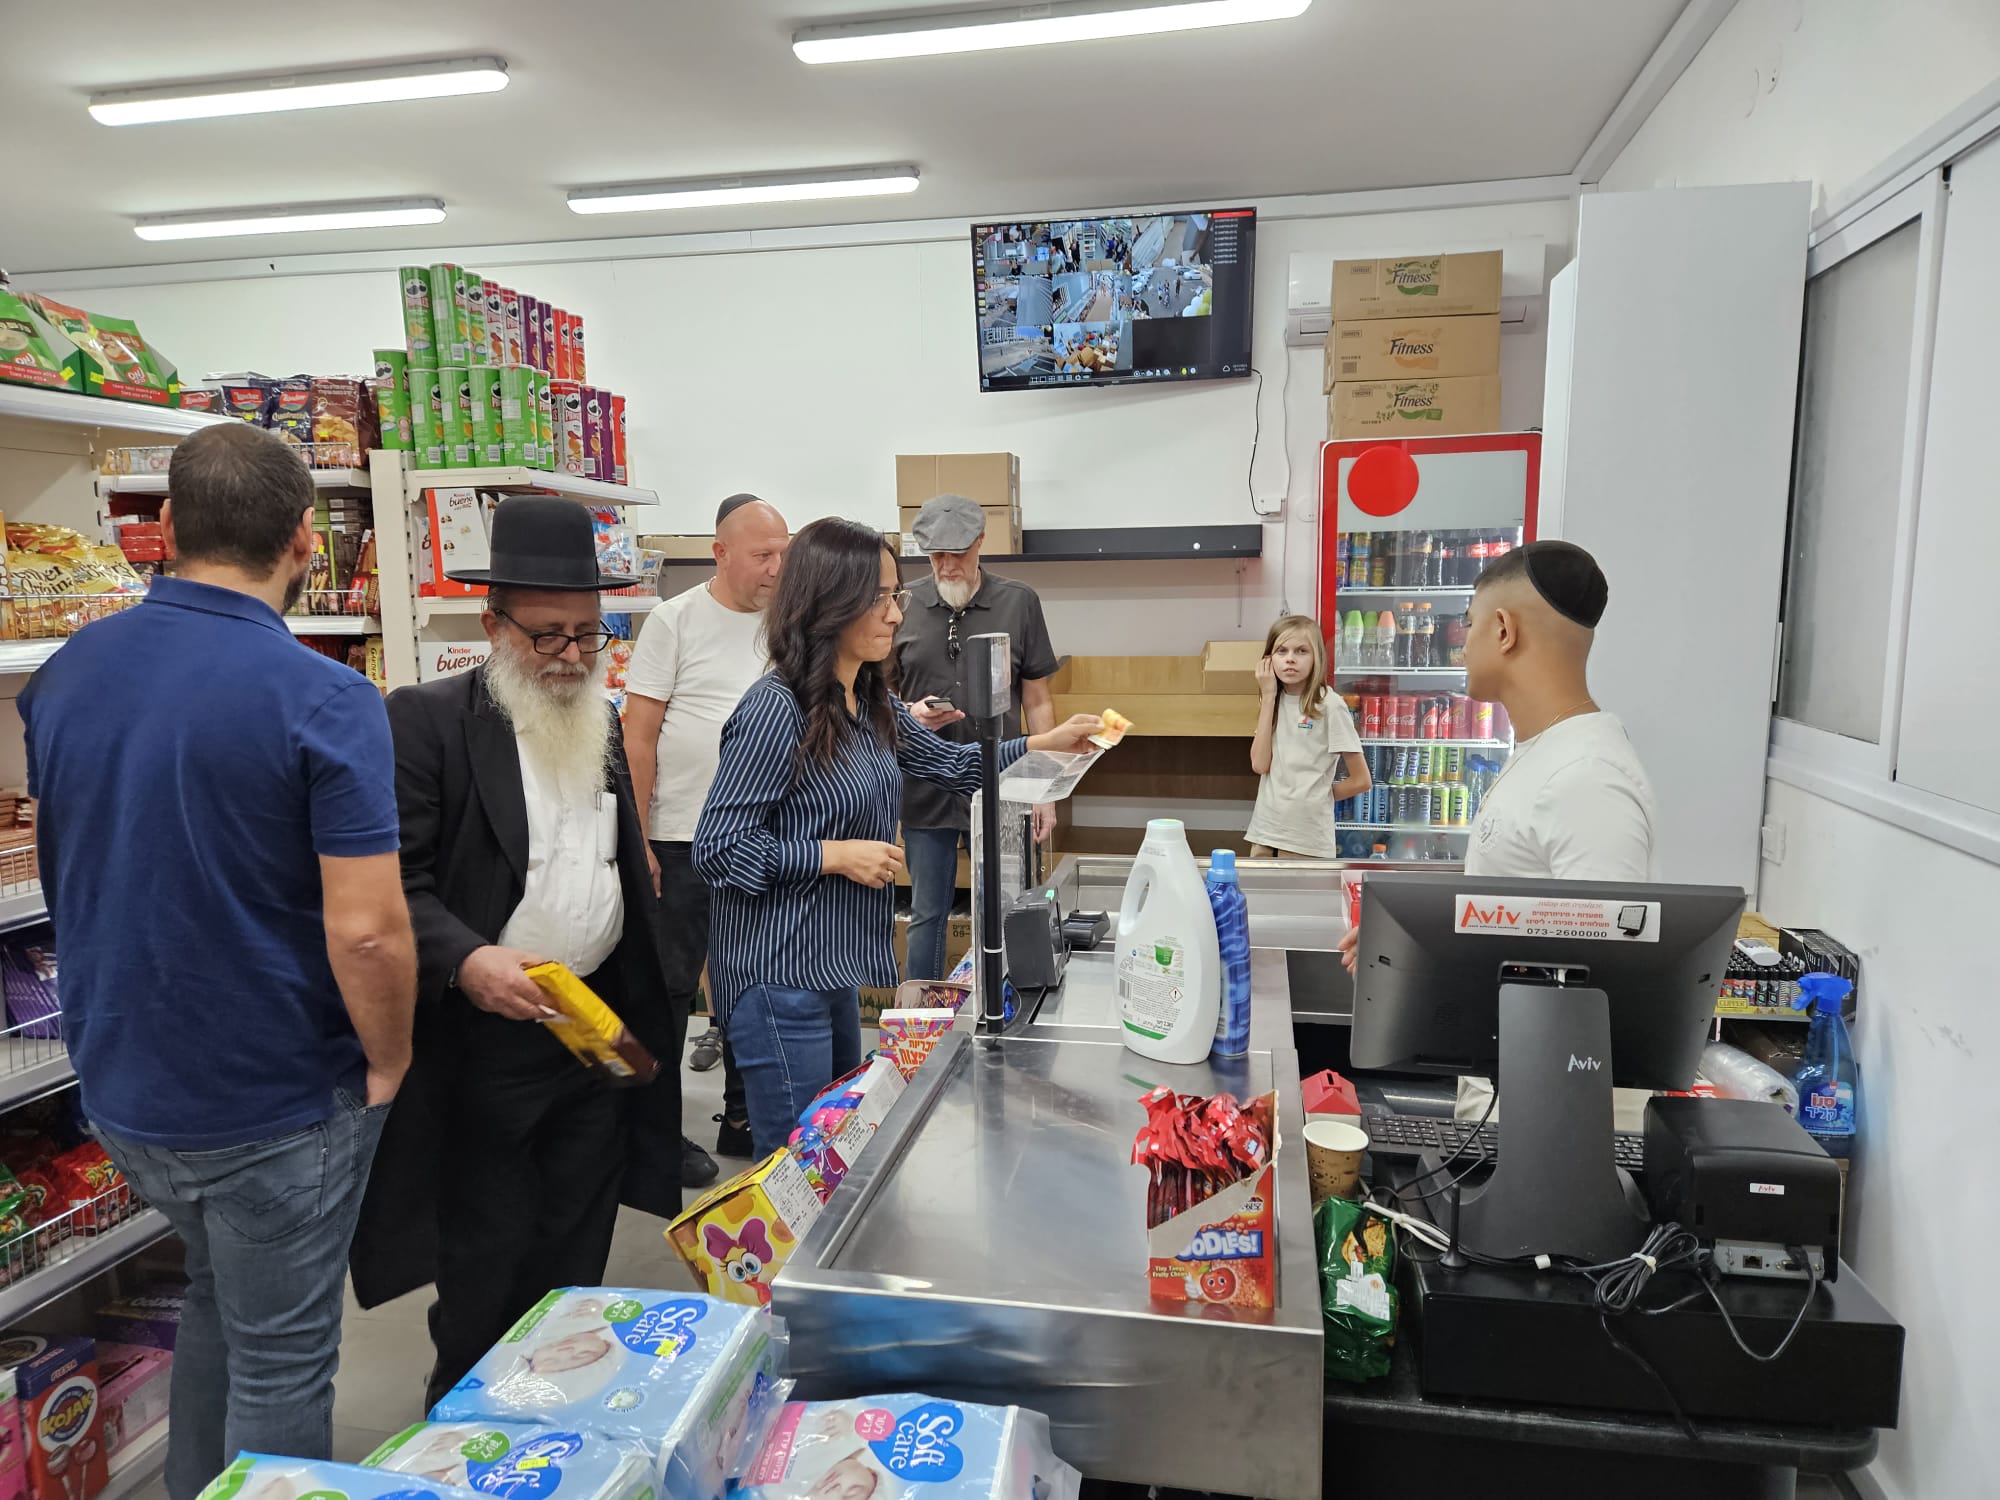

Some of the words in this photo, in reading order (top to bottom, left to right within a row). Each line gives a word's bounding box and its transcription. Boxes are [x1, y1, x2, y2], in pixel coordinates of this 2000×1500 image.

[1391, 269, 1432, 285] Fitness
[1389, 338, 1434, 355] Fitness
[1393, 392, 1433, 408] Fitness
[449, 495, 473, 507] bueno
[436, 653, 485, 673] bueno
[1460, 900, 1521, 928] Aviv
[1526, 928, 1608, 938] 073-2600000
[909, 1040, 937, 1053] וכריות
[899, 1048, 927, 1065] פצות
[1567, 1054, 1602, 1073] Aviv
[1811, 1092, 1837, 1109] סנו
[625, 1310, 660, 1345] care
[643, 1306, 698, 1345] Soft
[40, 1389, 95, 1439] KOJAK
[889, 1421, 916, 1470] care
[909, 1412, 955, 1468] Soft
